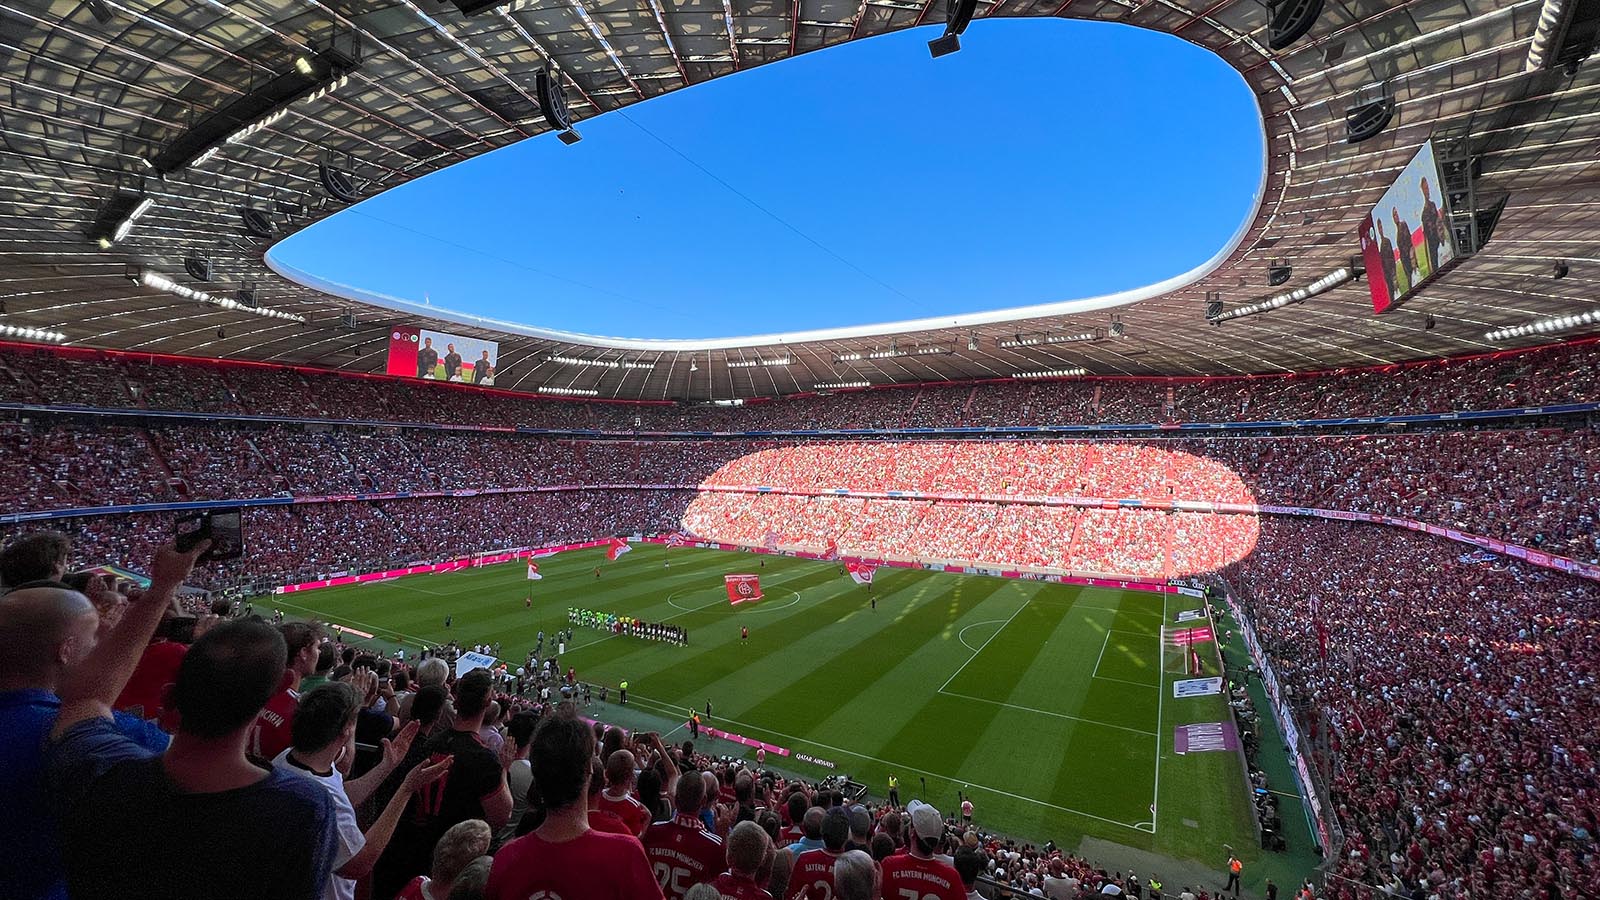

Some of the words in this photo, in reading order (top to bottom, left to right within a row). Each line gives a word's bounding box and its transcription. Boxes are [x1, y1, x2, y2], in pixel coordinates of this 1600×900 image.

[796, 753, 812, 761] QATAR
[655, 848, 676, 858] BAYERN
[805, 863, 825, 872] BAYERN
[892, 871, 899, 879] FC
[900, 870, 923, 880] BAYERN
